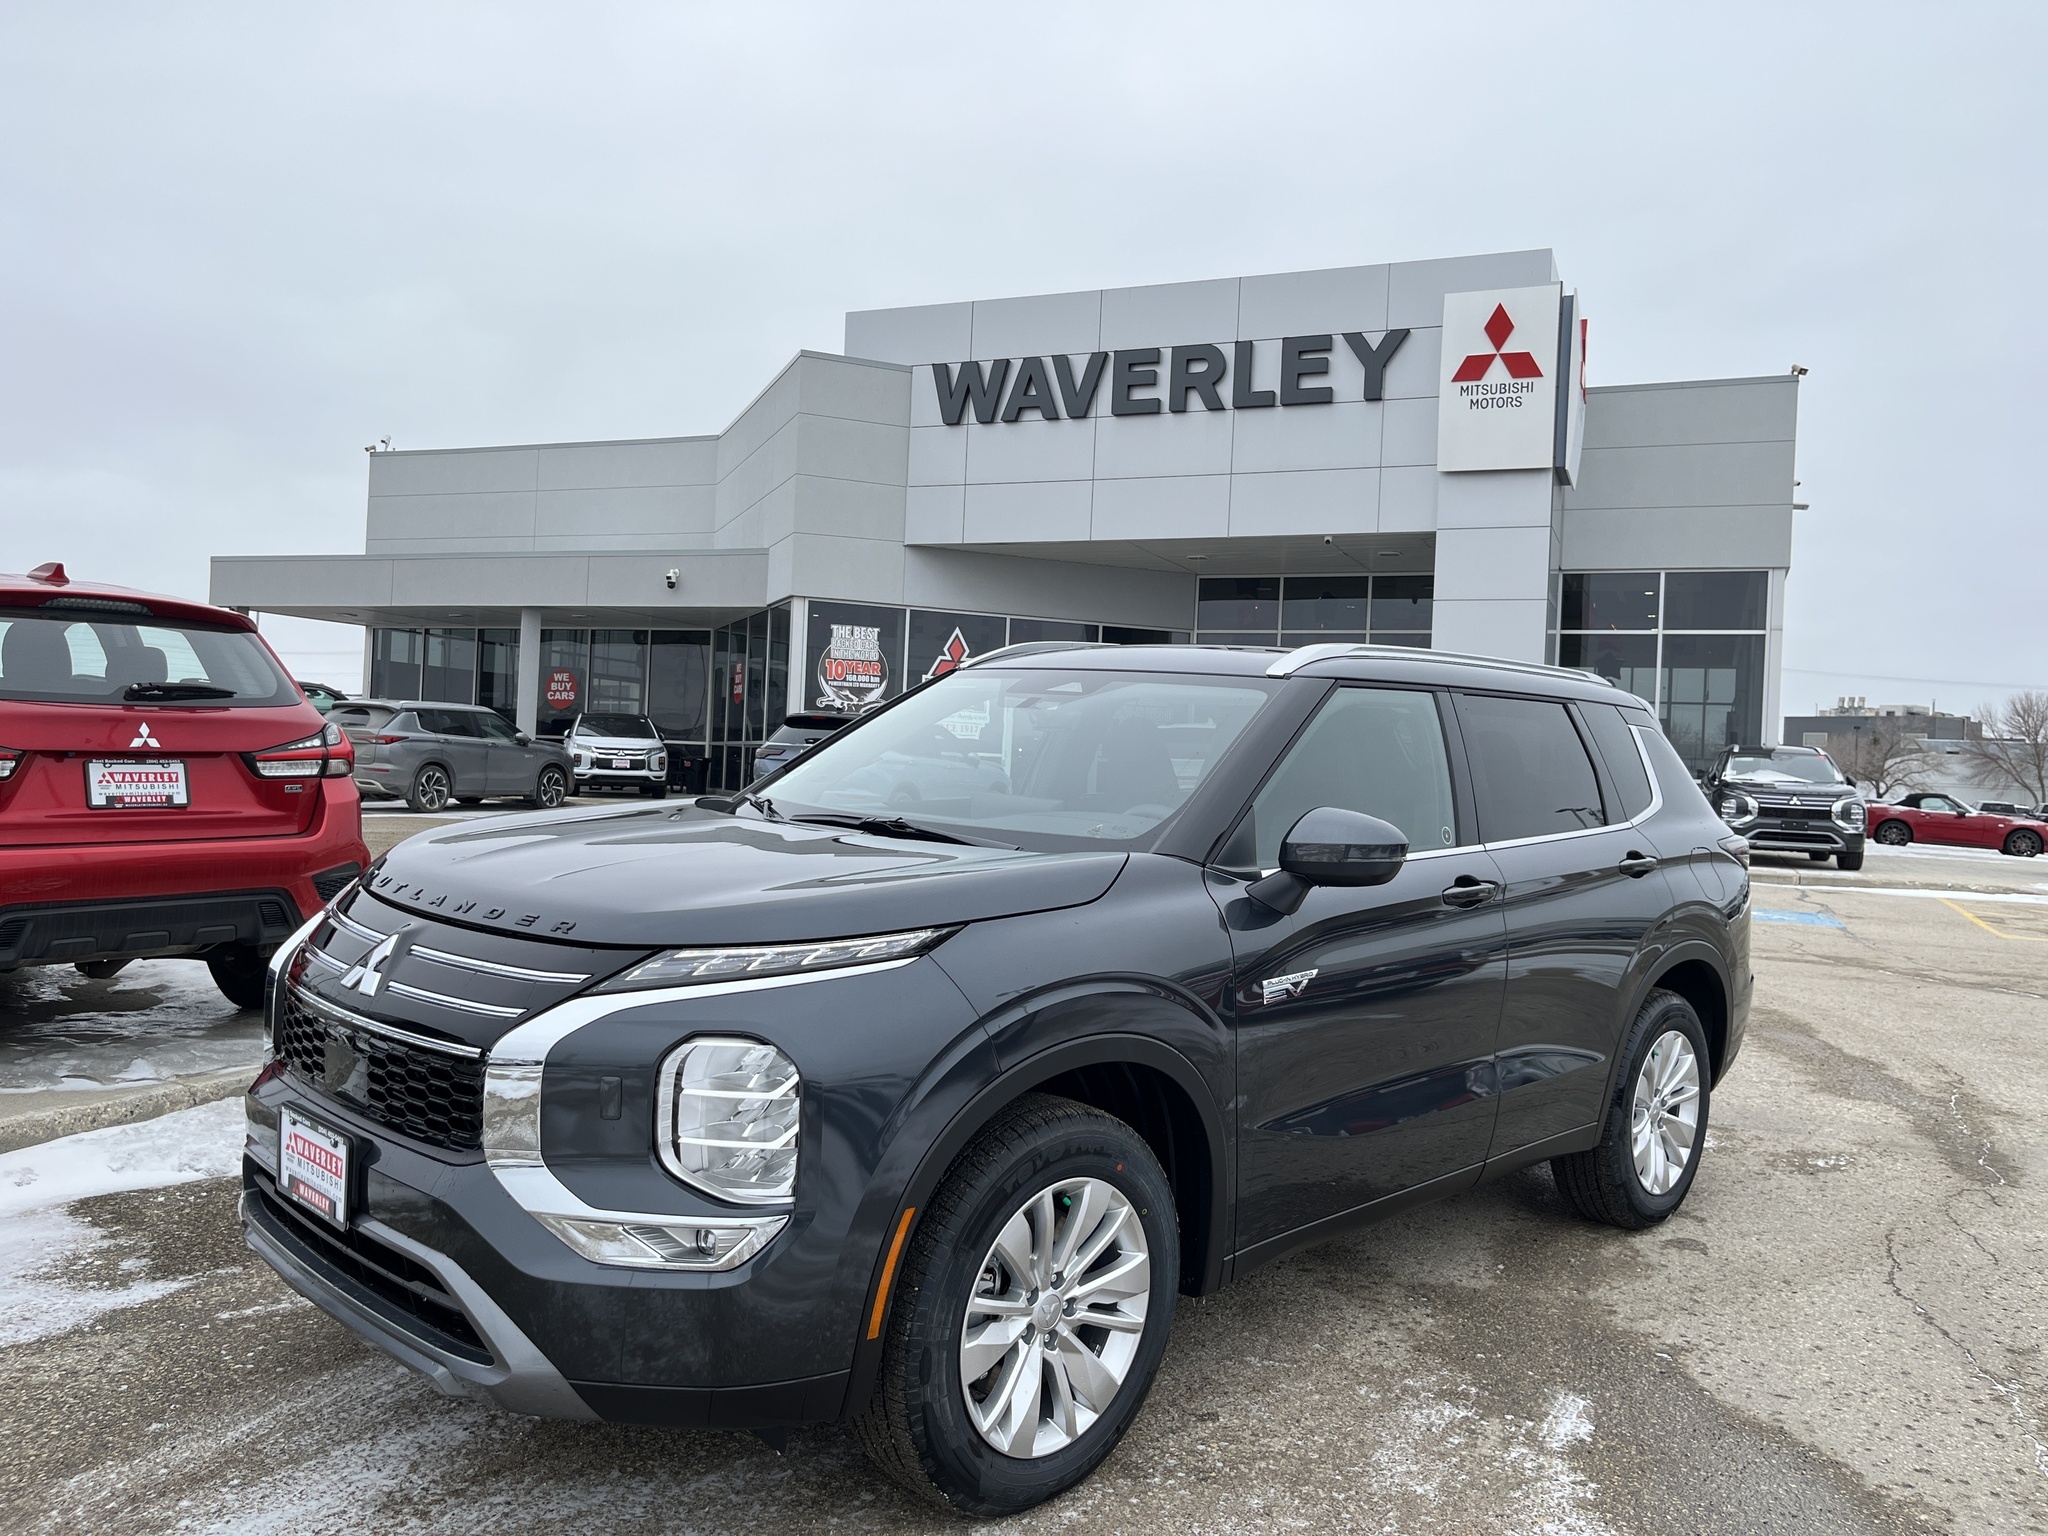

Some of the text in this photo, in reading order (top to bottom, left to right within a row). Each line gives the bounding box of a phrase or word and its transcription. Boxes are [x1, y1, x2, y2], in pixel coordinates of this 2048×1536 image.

[932, 328, 1411, 426] WAVERLEY
[1460, 381, 1534, 397] MITSUBISHI
[1469, 395, 1523, 410] MOTORS
[831, 624, 880, 640] THE BEST
[832, 639, 880, 651] BACKED CARS
[831, 649, 879, 660] IN THE WORLD
[826, 659, 881, 681] 10 YEAR
[553, 673, 570, 681] WE
[846, 674, 870, 683] 160,000
[551, 682, 572, 691] BUY
[547, 691, 575, 700] CARS
[960, 725, 979, 733] 1917
[113, 773, 177, 782] WAVERLEY
[296, 1137, 343, 1177] WAVERLEY
[297, 1156, 342, 1192] MITSUBISHI
[300, 1182, 330, 1213] WAVERLEY
